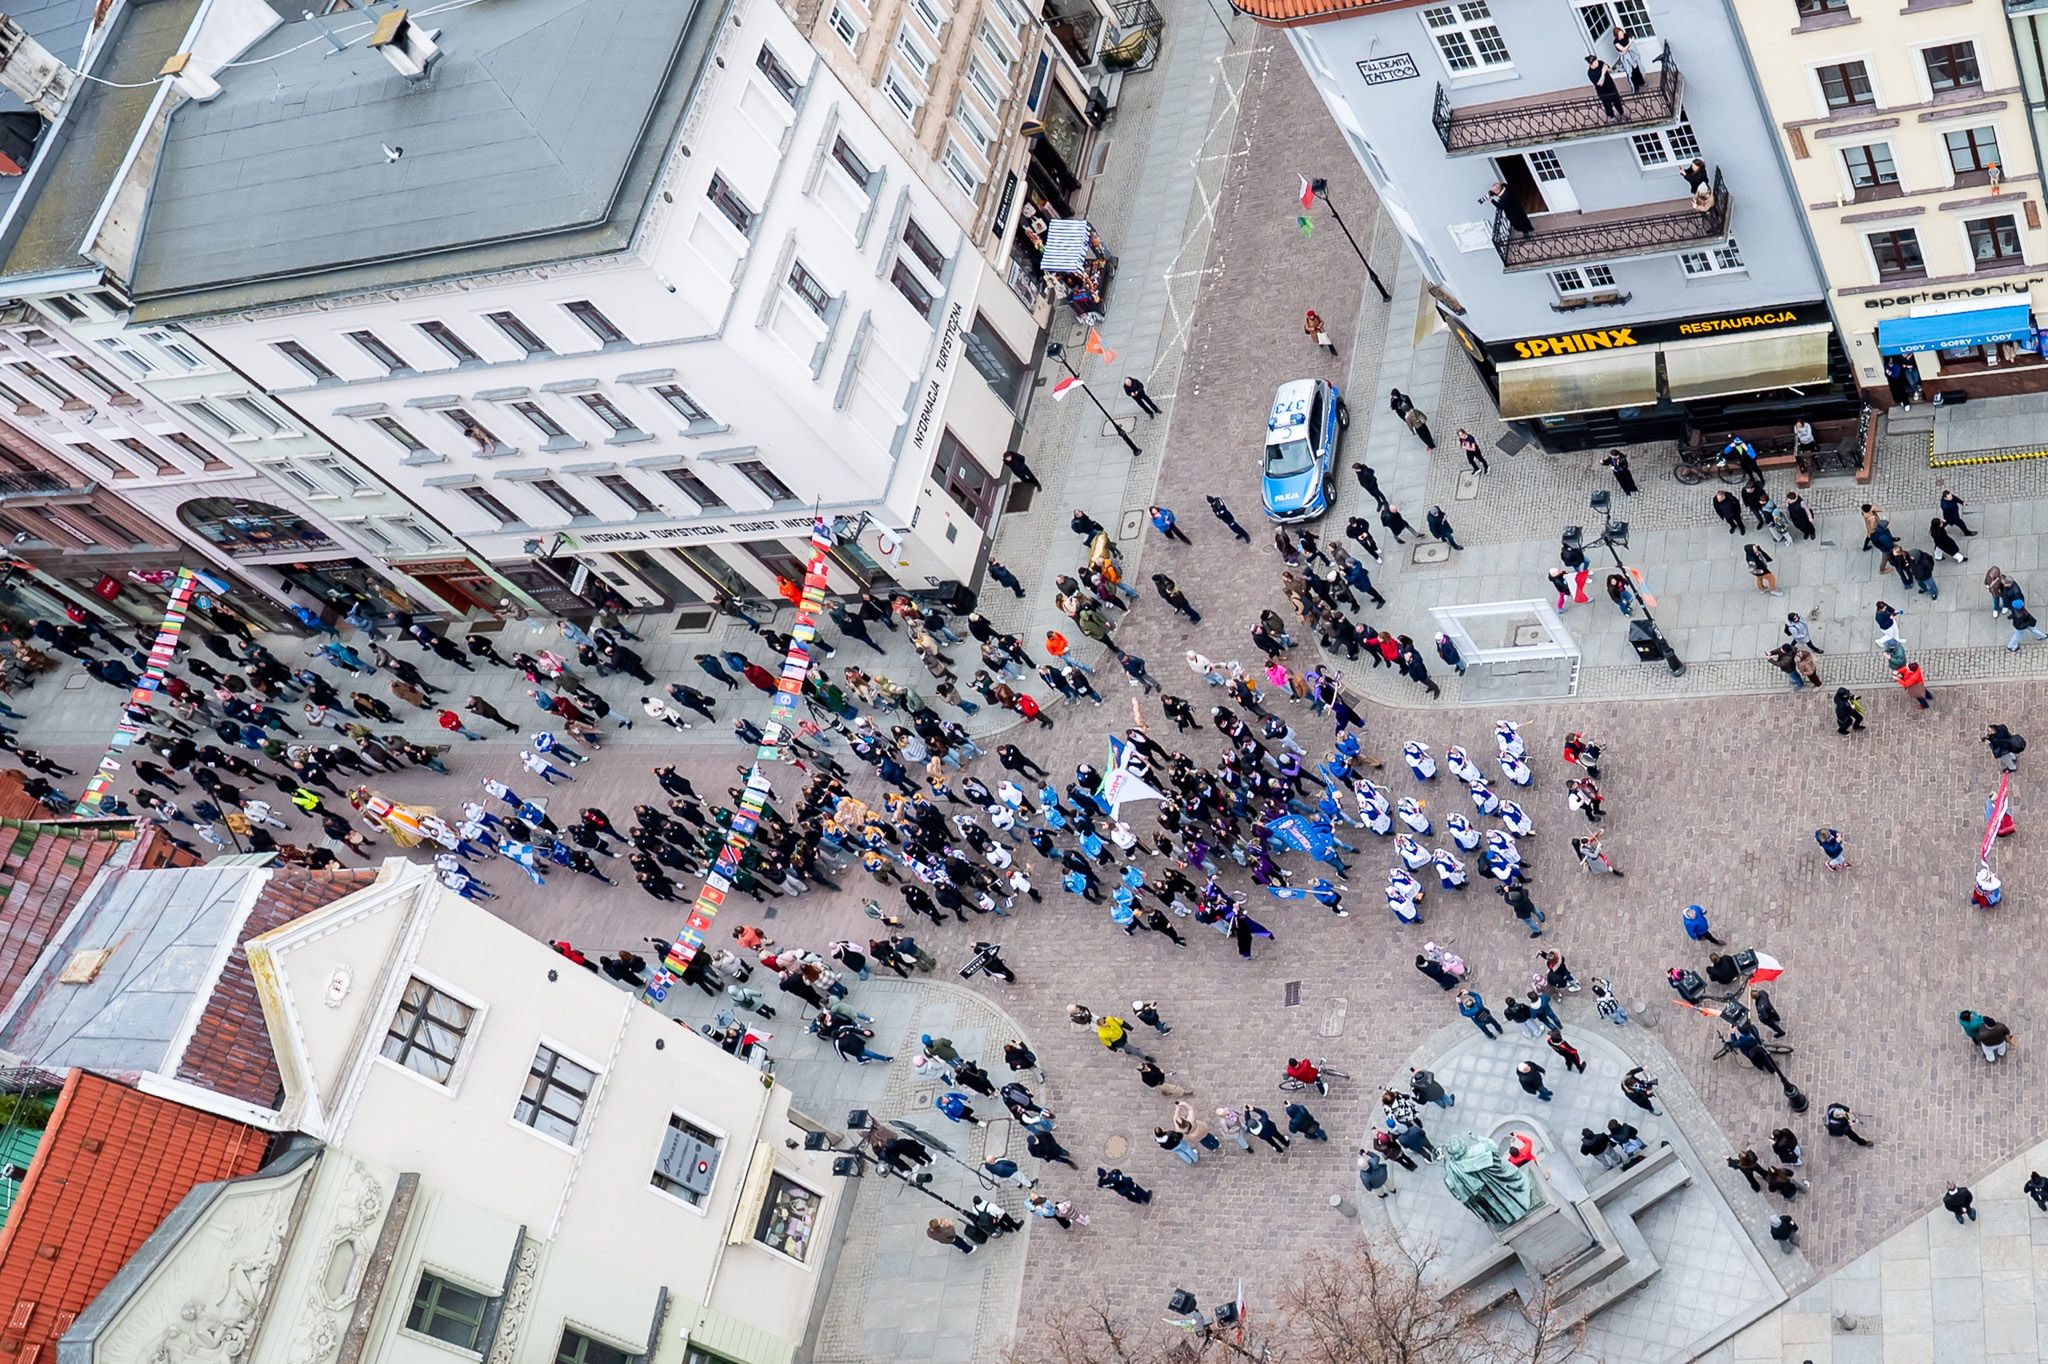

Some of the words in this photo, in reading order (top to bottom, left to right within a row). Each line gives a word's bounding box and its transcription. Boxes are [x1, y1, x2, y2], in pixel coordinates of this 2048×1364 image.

[1361, 63, 1379, 71] TILL
[1379, 57, 1410, 69] DEATH
[1366, 66, 1414, 82] TATTOO
[1679, 311, 1797, 334] RESTAURACJA
[1514, 328, 1637, 358] SPHINX
[1900, 344, 1925, 352] LODY
[1940, 338, 1972, 347] GOFRY
[1986, 333, 2012, 342] LODY
[913, 380, 940, 449] INFORMACJA
[936, 302, 962, 372] TURYSTYCZNA
[1275, 399, 1305, 414] 373
[1274, 491, 1299, 502] POLICJA
[580, 530, 650, 543] INFORMACJA
[650, 524, 729, 539] TURYSTYCZNA
[730, 520, 780, 533] TOURIST
